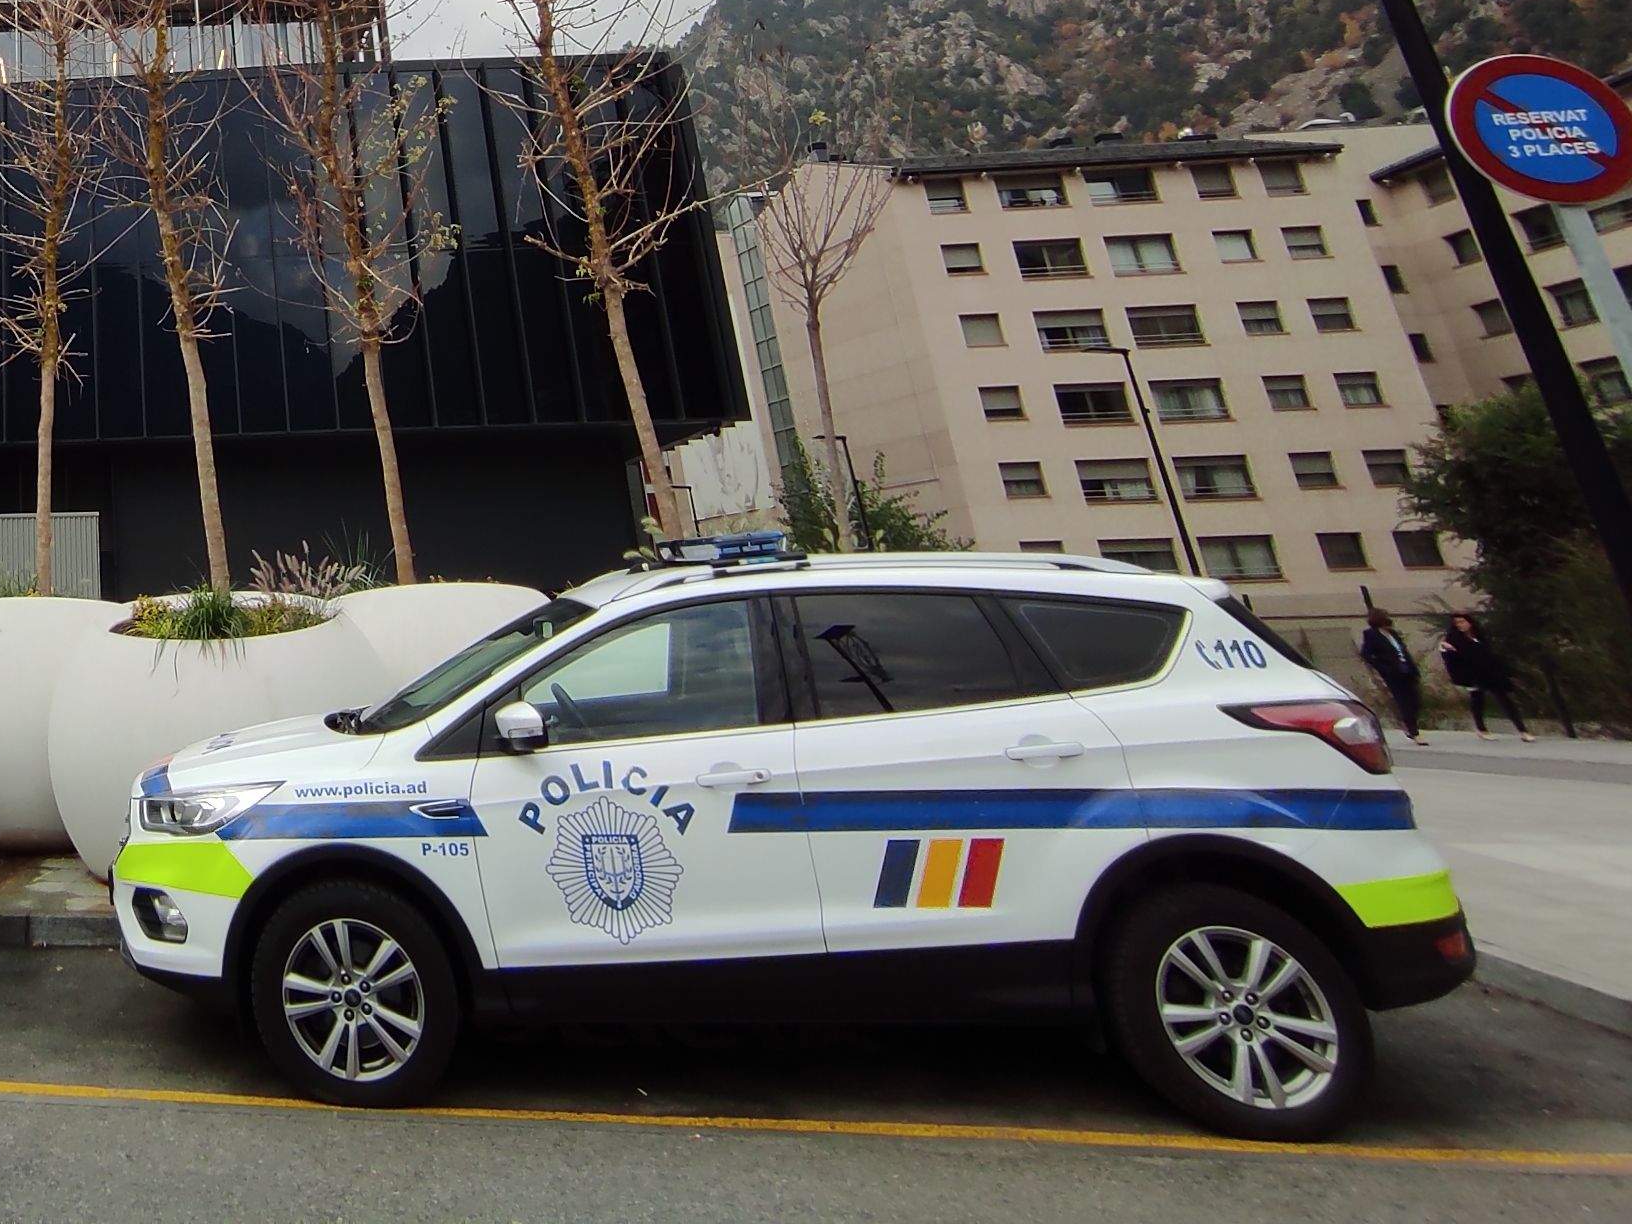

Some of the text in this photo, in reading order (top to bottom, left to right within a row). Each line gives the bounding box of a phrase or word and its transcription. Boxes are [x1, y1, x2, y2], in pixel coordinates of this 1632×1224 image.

[1491, 109, 1587, 126] RESERVAT
[1508, 126, 1586, 142] POLICIA
[1508, 141, 1600, 158] 3 PLACES
[1214, 639, 1267, 668] 110
[294, 780, 427, 798] www.policia.ad
[519, 760, 695, 836] POLICIA
[591, 835, 629, 844] POLICIA
[421, 843, 469, 857] P-105
